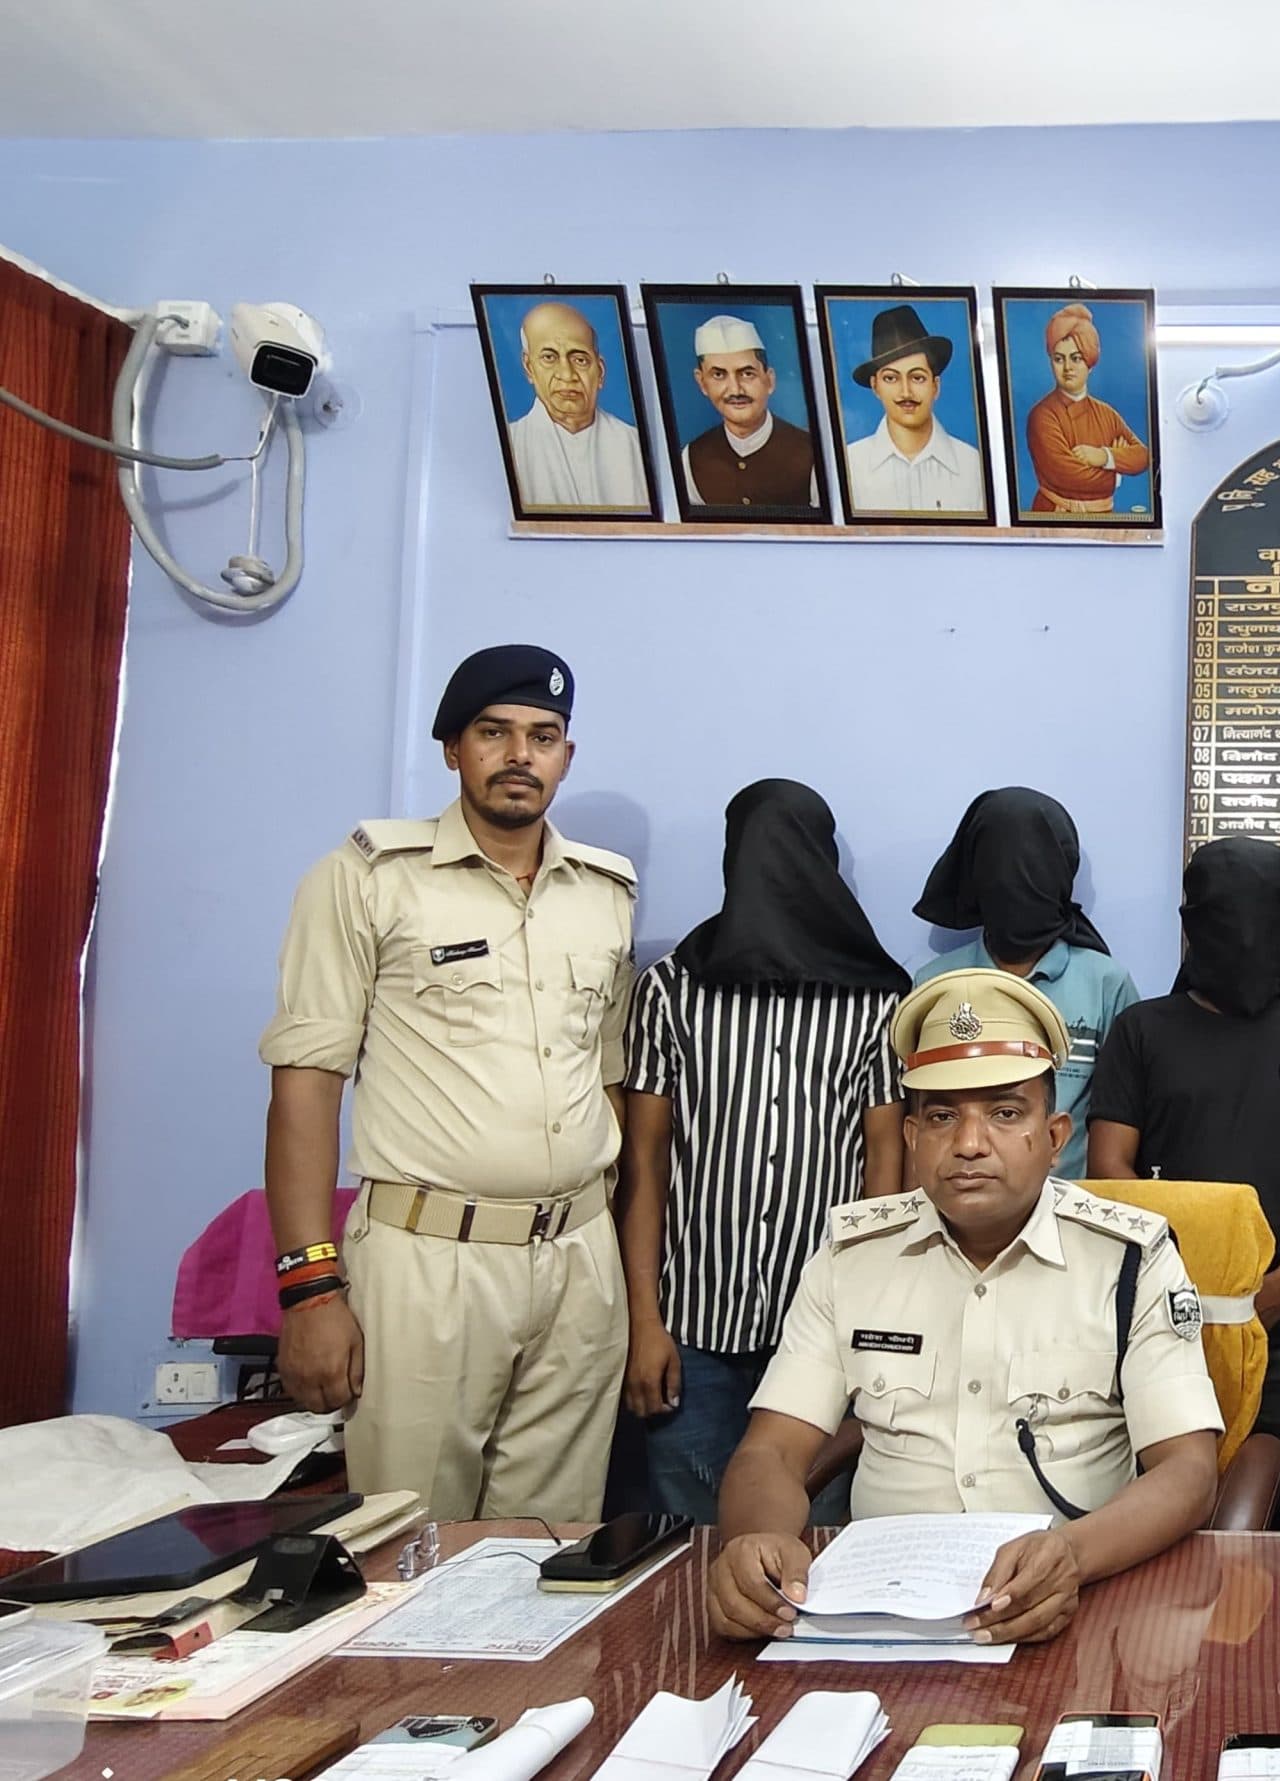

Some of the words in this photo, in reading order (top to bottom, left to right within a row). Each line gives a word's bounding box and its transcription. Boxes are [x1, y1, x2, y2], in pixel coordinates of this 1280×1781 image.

[1197, 601, 1213, 615] 01
[1197, 622, 1213, 636] 02
[1196, 643, 1212, 658] 03
[1195, 663, 1210, 678] 04
[1225, 665, 1279, 676] संजय
[1195, 684, 1210, 698] 05
[1194, 704, 1210, 719] 06
[1193, 726, 1209, 741] 07
[1193, 748, 1210, 764] 08
[1193, 771, 1209, 787] 09
[1193, 795, 1208, 810] 10
[1190, 818, 1207, 834] 11
